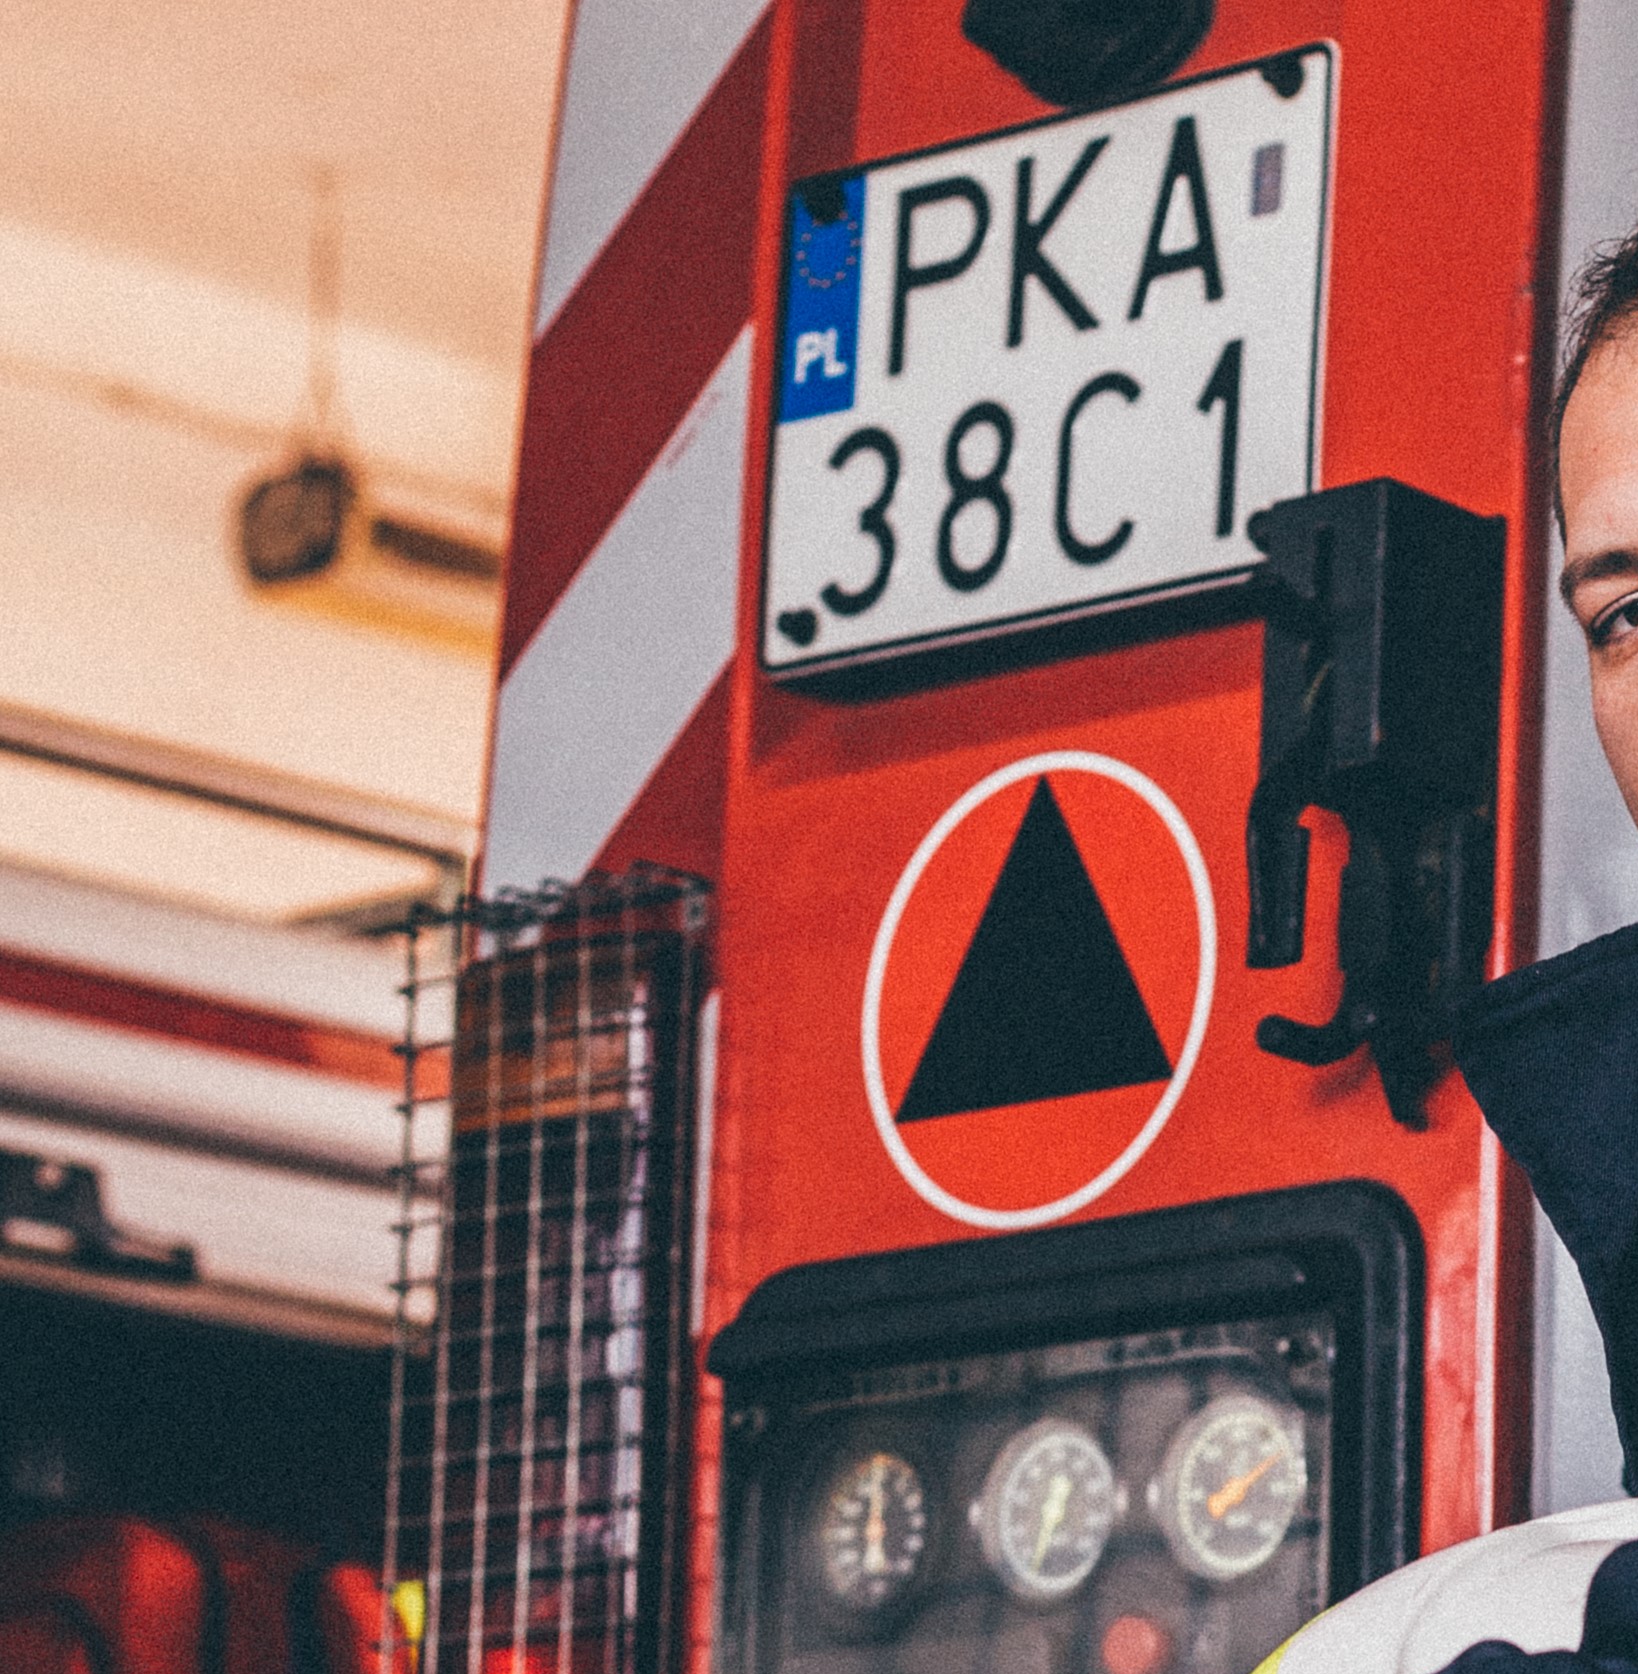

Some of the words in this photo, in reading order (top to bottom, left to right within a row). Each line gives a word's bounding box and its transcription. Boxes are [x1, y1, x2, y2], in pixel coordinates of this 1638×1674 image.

[794, 328, 848, 385] PL
[887, 115, 1224, 377] PKA
[820, 337, 1244, 618] 38C1
